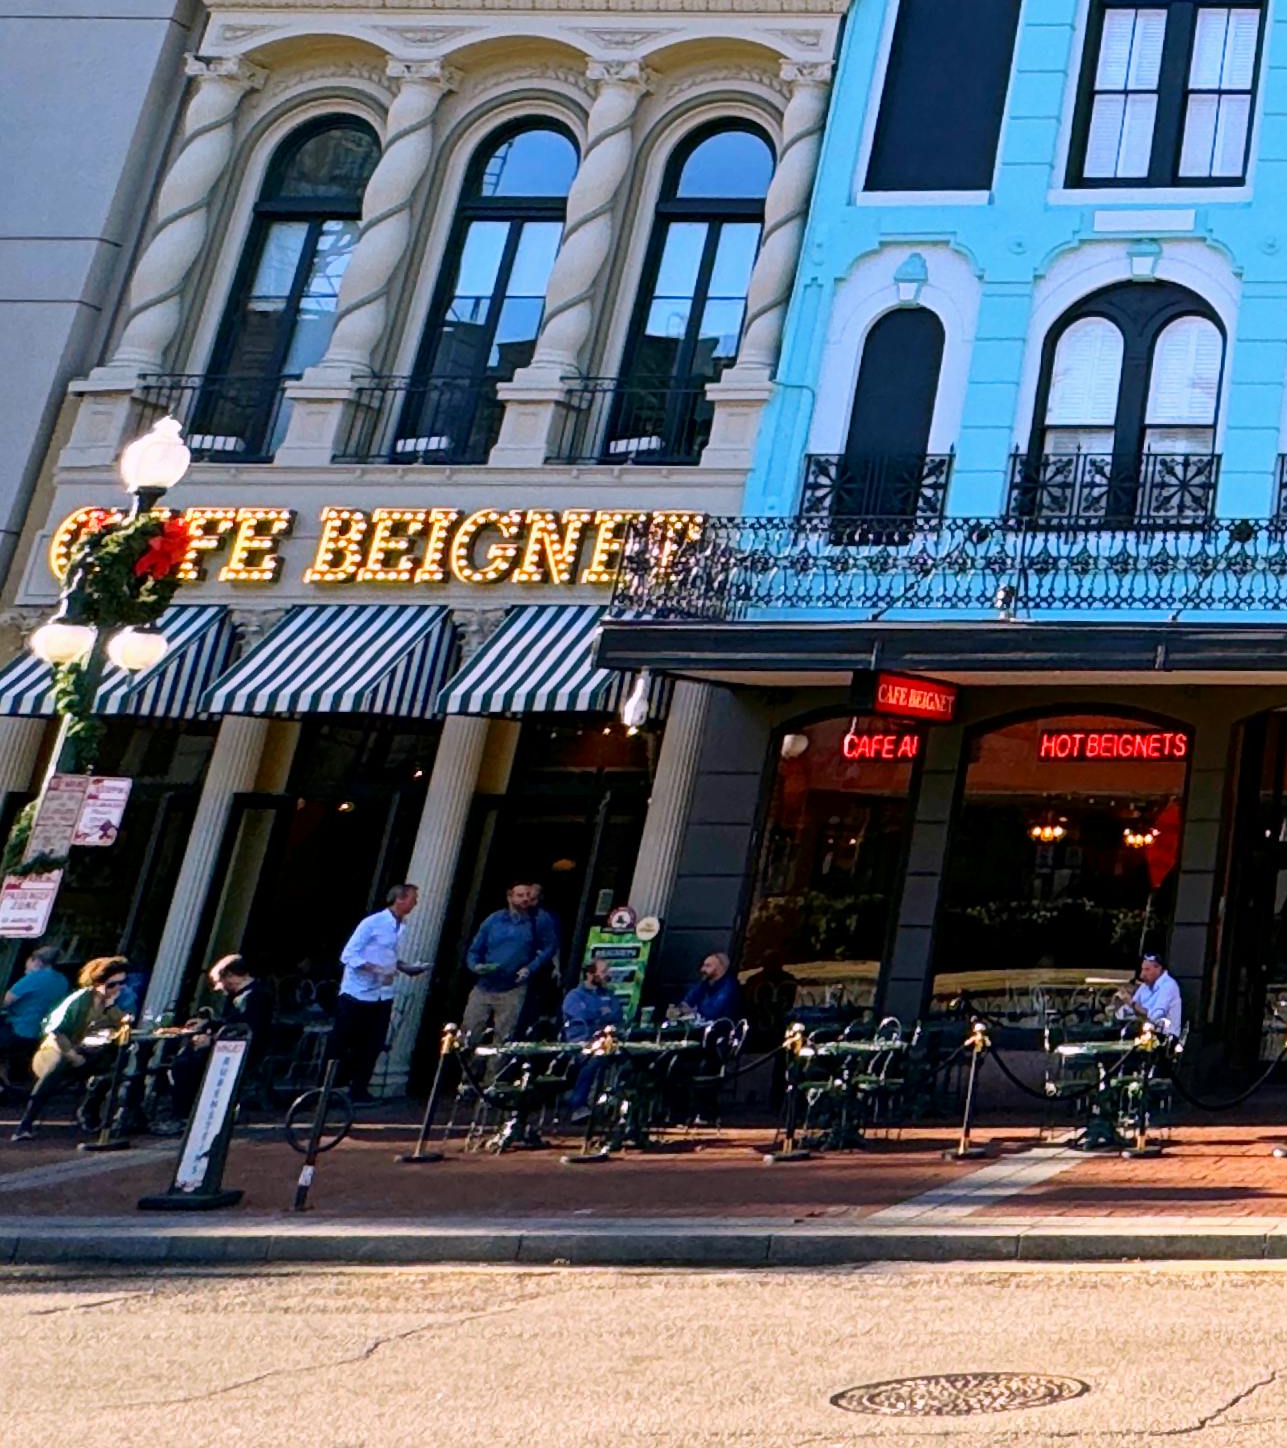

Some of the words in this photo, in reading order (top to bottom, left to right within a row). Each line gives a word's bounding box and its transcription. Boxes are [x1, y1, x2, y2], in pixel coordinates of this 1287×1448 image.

[50, 506, 292, 583] CFE
[878, 683, 908, 706] CAFE
[908, 688, 956, 713] BEIGNET
[843, 733, 897, 759] CAFE
[1040, 733, 1086, 758] HOT
[1086, 732, 1188, 758] BEIGNETS
